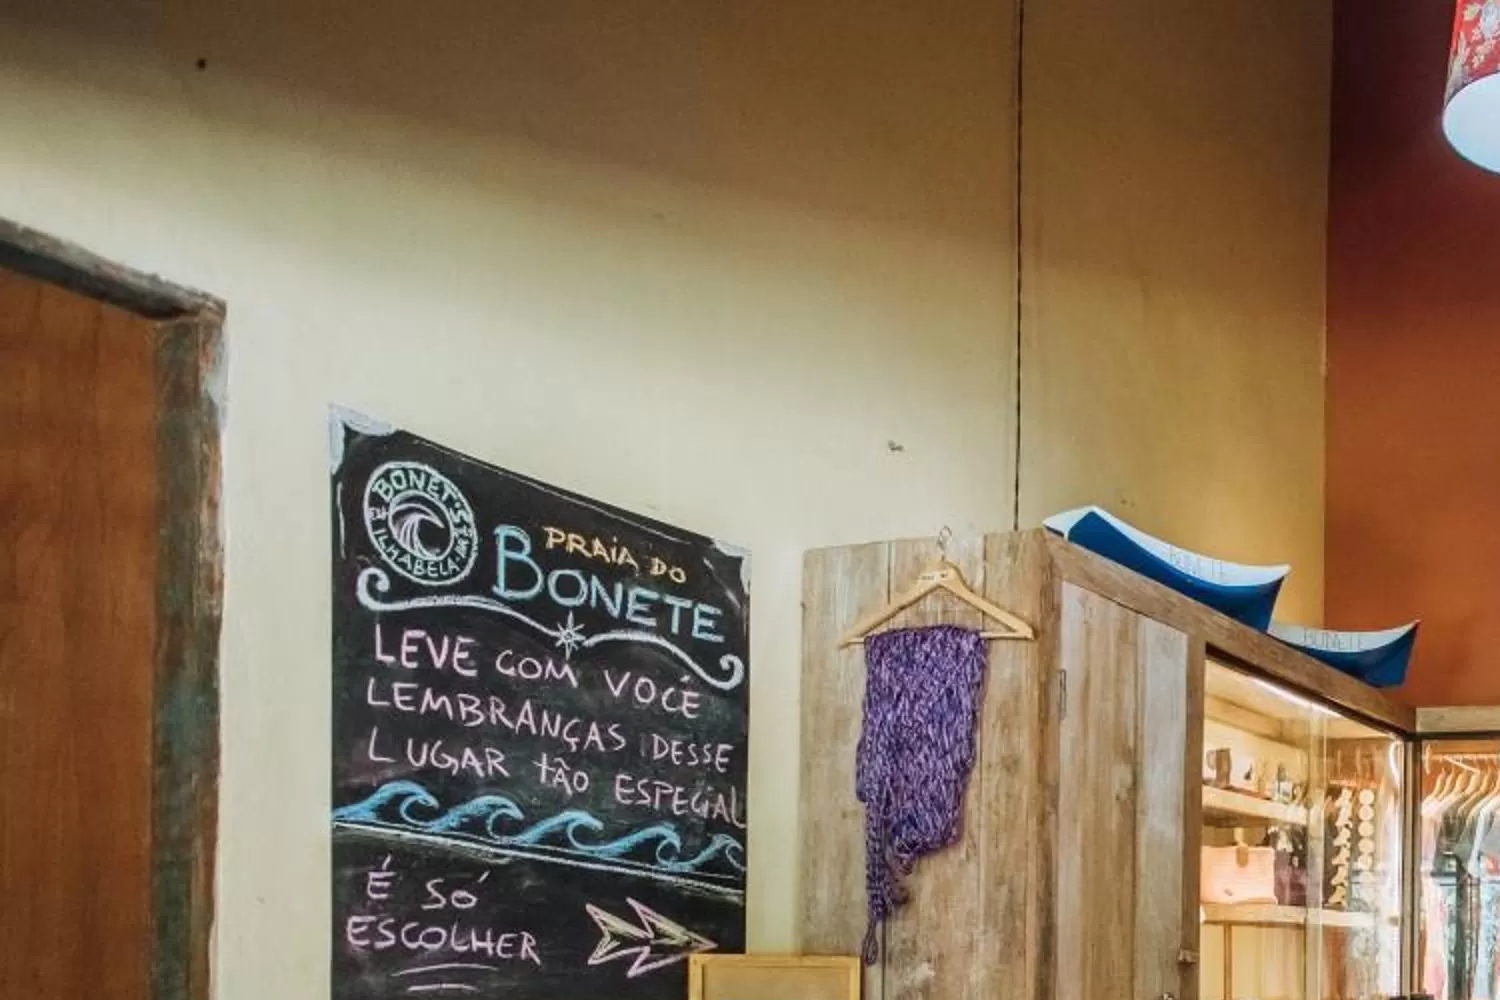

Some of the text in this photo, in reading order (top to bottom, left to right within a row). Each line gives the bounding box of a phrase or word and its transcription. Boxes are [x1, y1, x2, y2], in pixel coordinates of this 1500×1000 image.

[493, 525, 725, 644] BONETE
[650, 557, 687, 584] DO
[375, 624, 478, 677] LEVE
[496, 650, 579, 688] COM
[367, 678, 734, 773] LEMBRANÇAS DESSE
[368, 727, 511, 778] LUGAR
[366, 854, 490, 911] É SÓ
[346, 914, 542, 965] ESCOLHER
